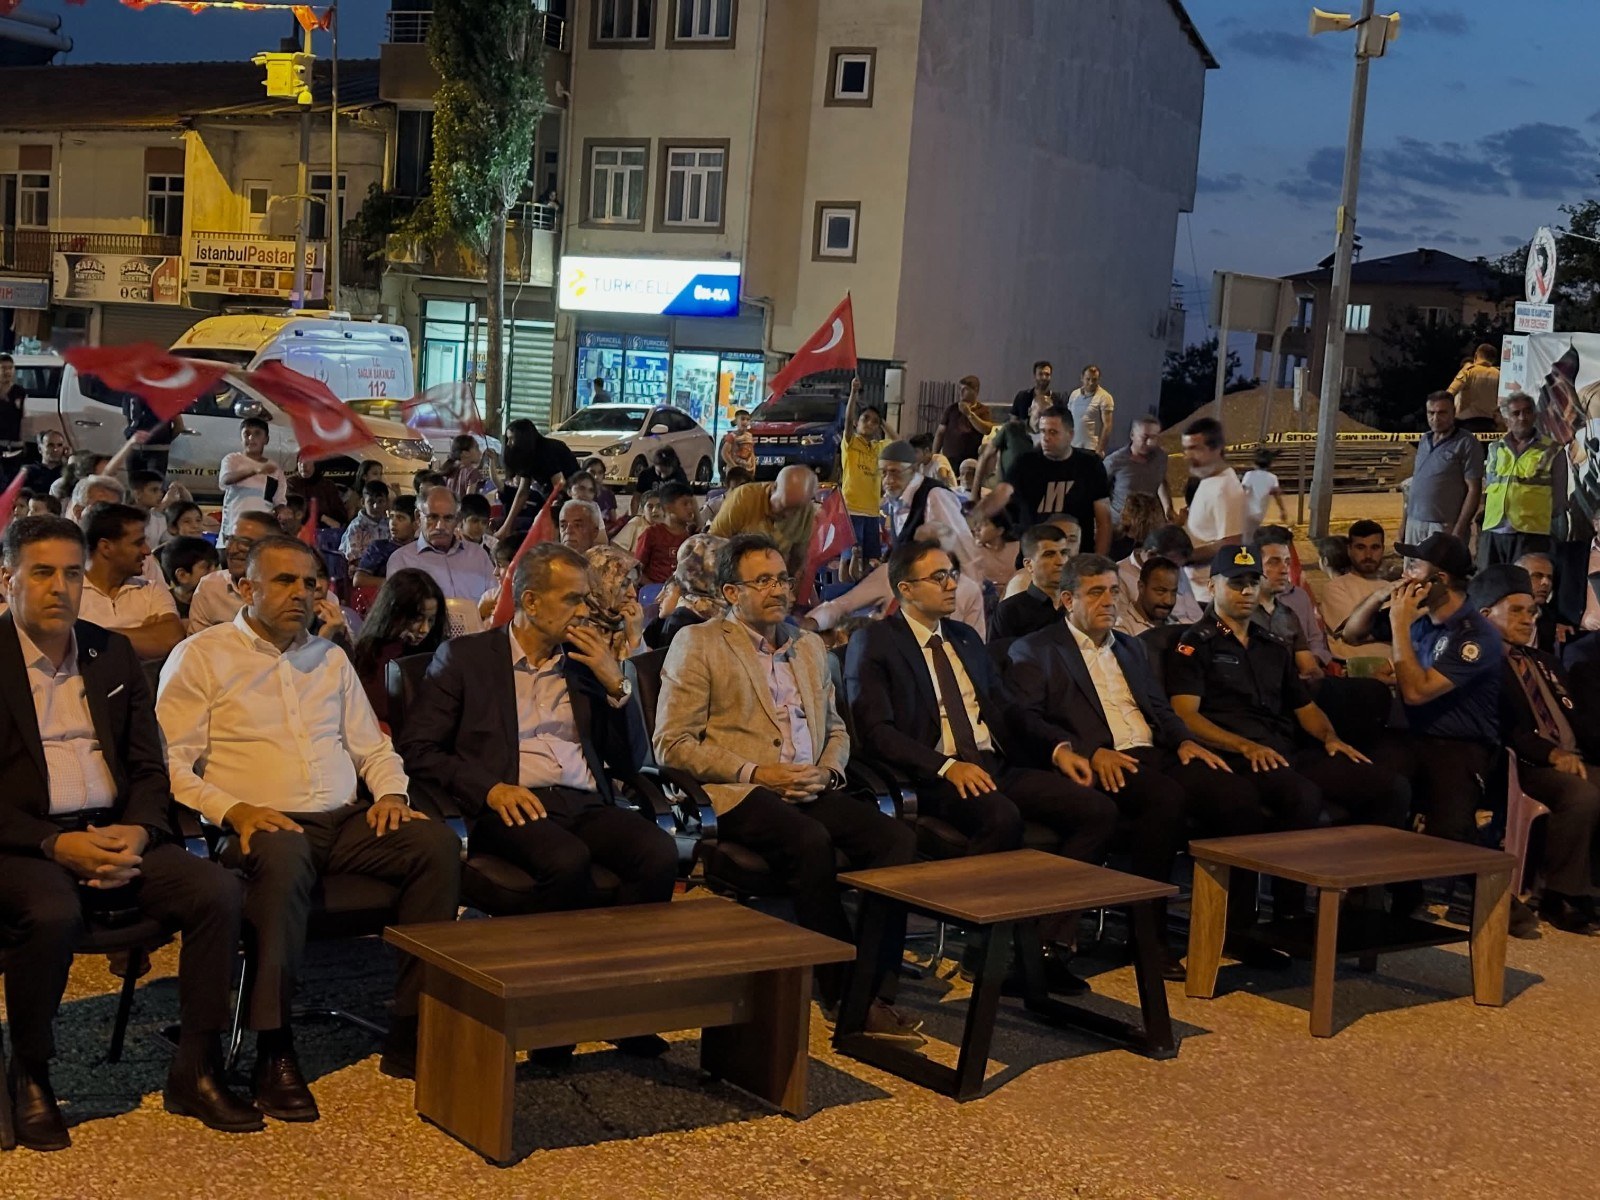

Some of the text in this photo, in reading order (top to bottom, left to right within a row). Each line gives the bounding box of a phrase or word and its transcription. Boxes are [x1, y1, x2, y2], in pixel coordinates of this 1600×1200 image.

[196, 240, 318, 266] İstanbulPastansi
[593, 276, 674, 295] TURKCELL
[368, 380, 387, 397] 112
